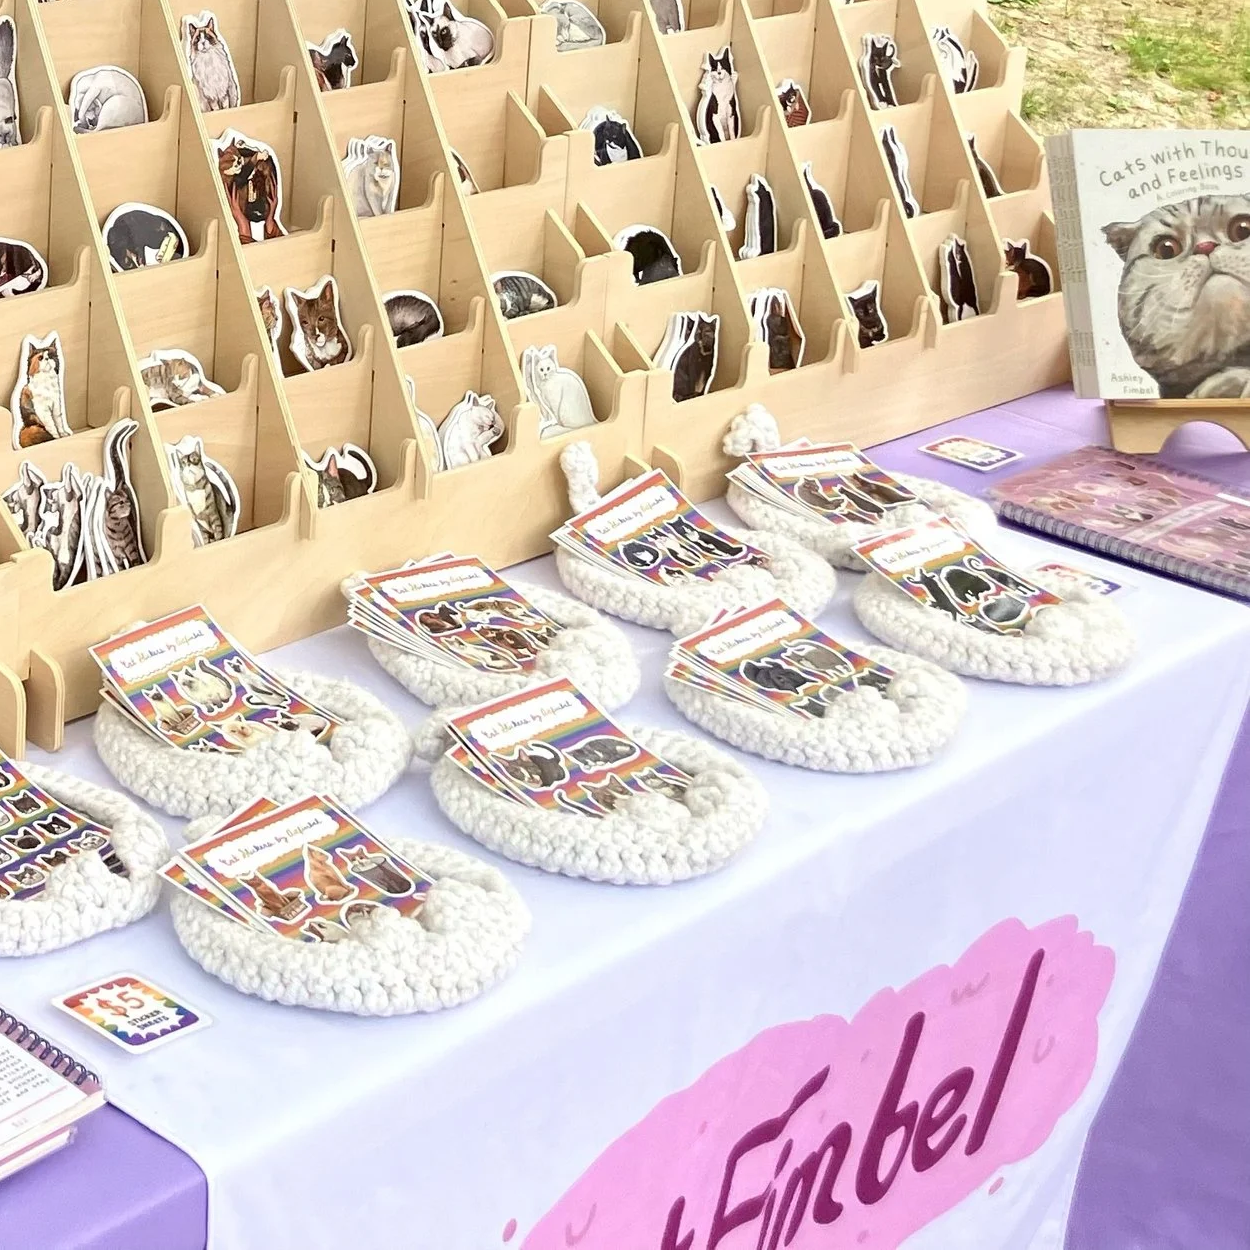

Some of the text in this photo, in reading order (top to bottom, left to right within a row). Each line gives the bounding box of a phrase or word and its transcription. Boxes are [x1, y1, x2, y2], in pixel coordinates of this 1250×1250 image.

[1099, 156, 1147, 188] Cats
[1150, 142, 1196, 165] with
[1128, 162, 1243, 200] and Feelings
[1110, 372, 1144, 384] Ashley
[1123, 385, 1154, 395] Fimbel
[96, 991, 145, 1018] $5
[127, 1010, 163, 1026] STICKER
[136, 1015, 170, 1031] SHEETS
